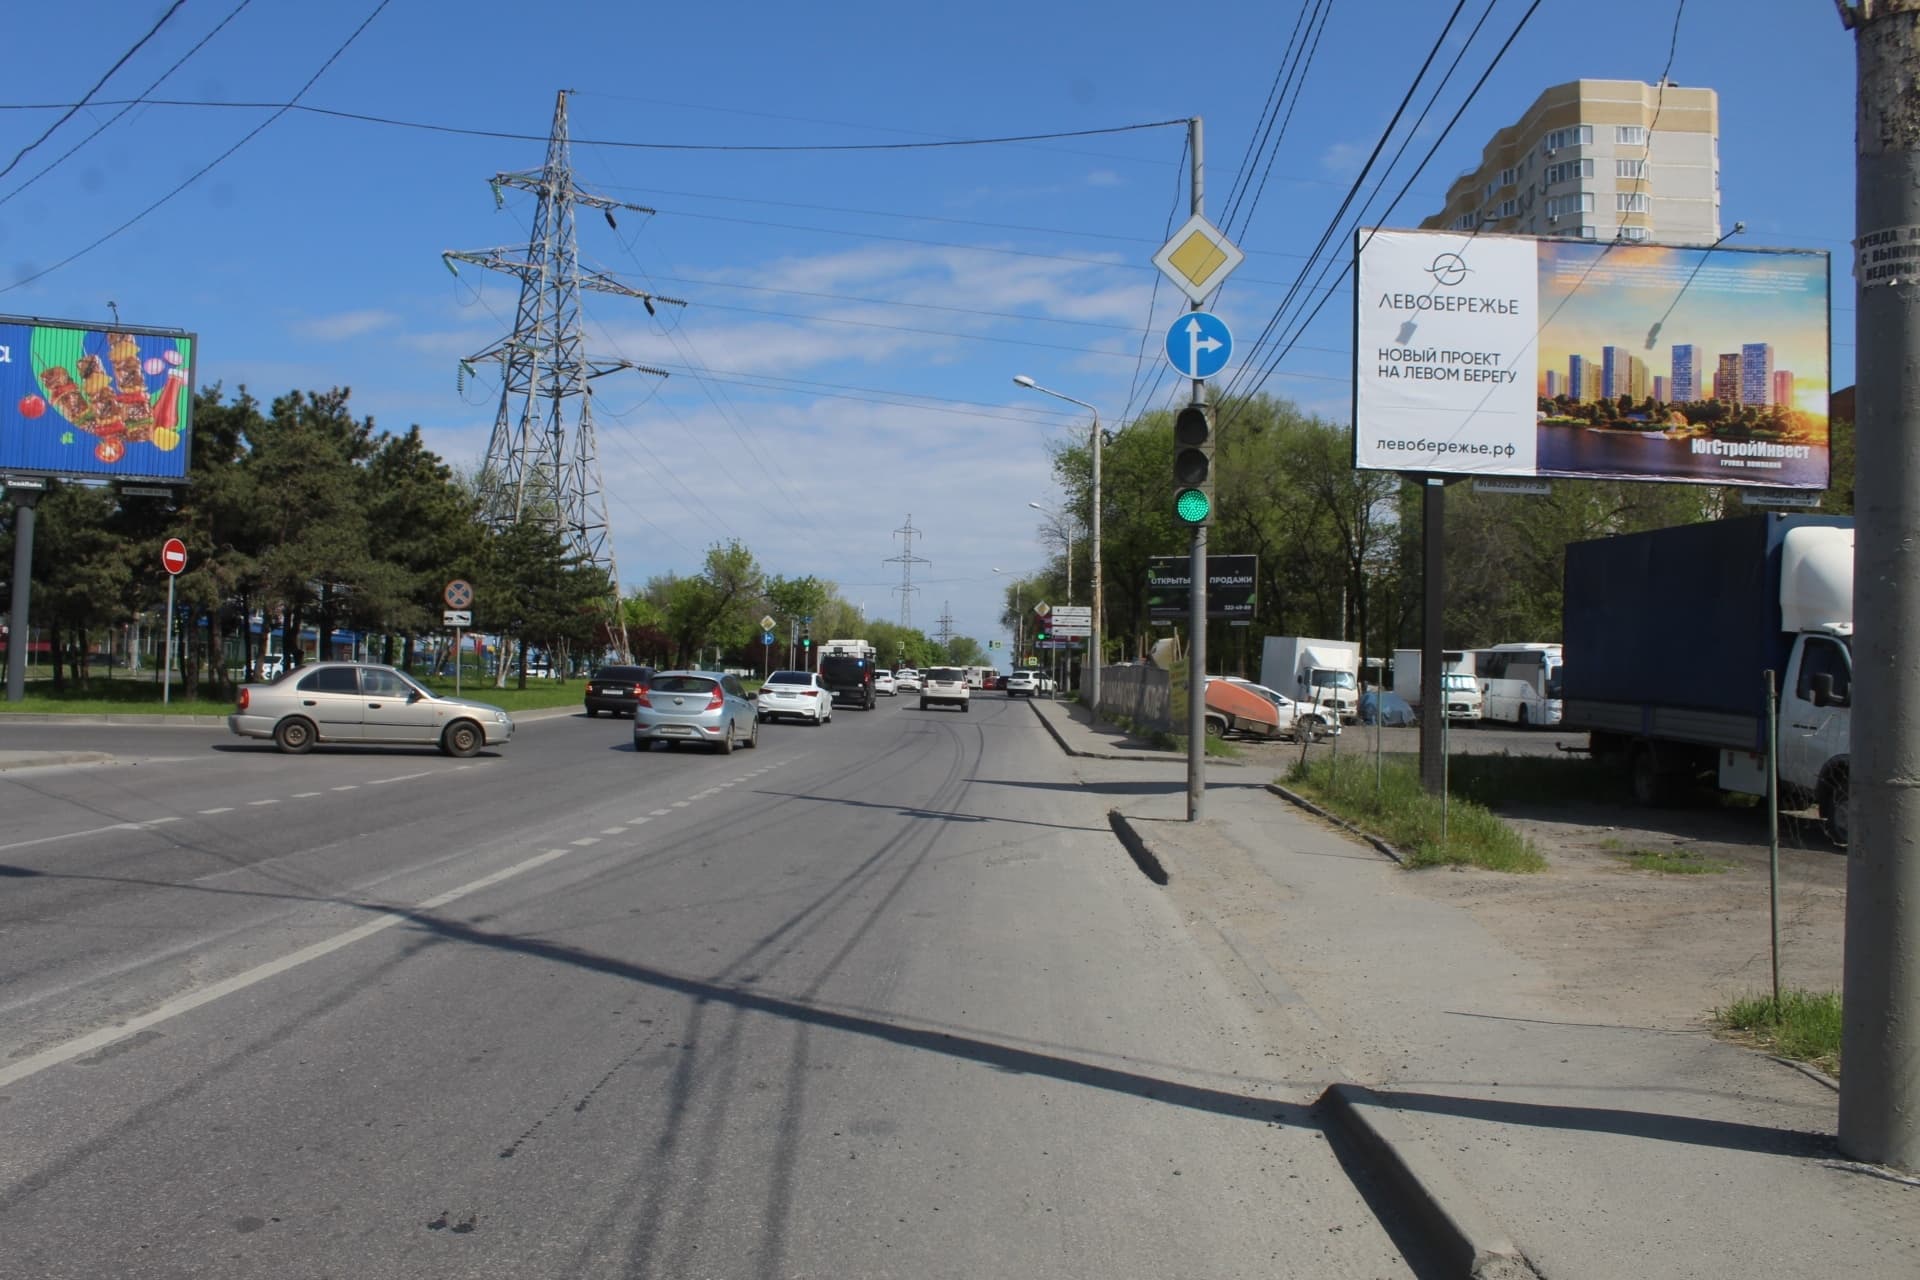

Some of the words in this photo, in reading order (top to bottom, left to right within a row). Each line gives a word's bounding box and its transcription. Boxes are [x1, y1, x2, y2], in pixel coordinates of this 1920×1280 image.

[1910, 227, 1920, 240] А
[1862, 253, 1867, 266] С
[1379, 293, 1519, 315] ЛЕВОБЕРЕЖЬЕ
[1378, 347, 1437, 363] НОВЫЙ
[1440, 350, 1501, 366] ПРОЕКТ
[1378, 365, 1400, 379] НА
[1403, 366, 1460, 381] ЛЕВОМ
[1463, 369, 1517, 383] БЕРЕГУ
[1376, 438, 1516, 458] левобережье.рф
[1691, 438, 1811, 459] ЮгСтройИнвест
[1209, 576, 1252, 584] ПРОДАЖИ
